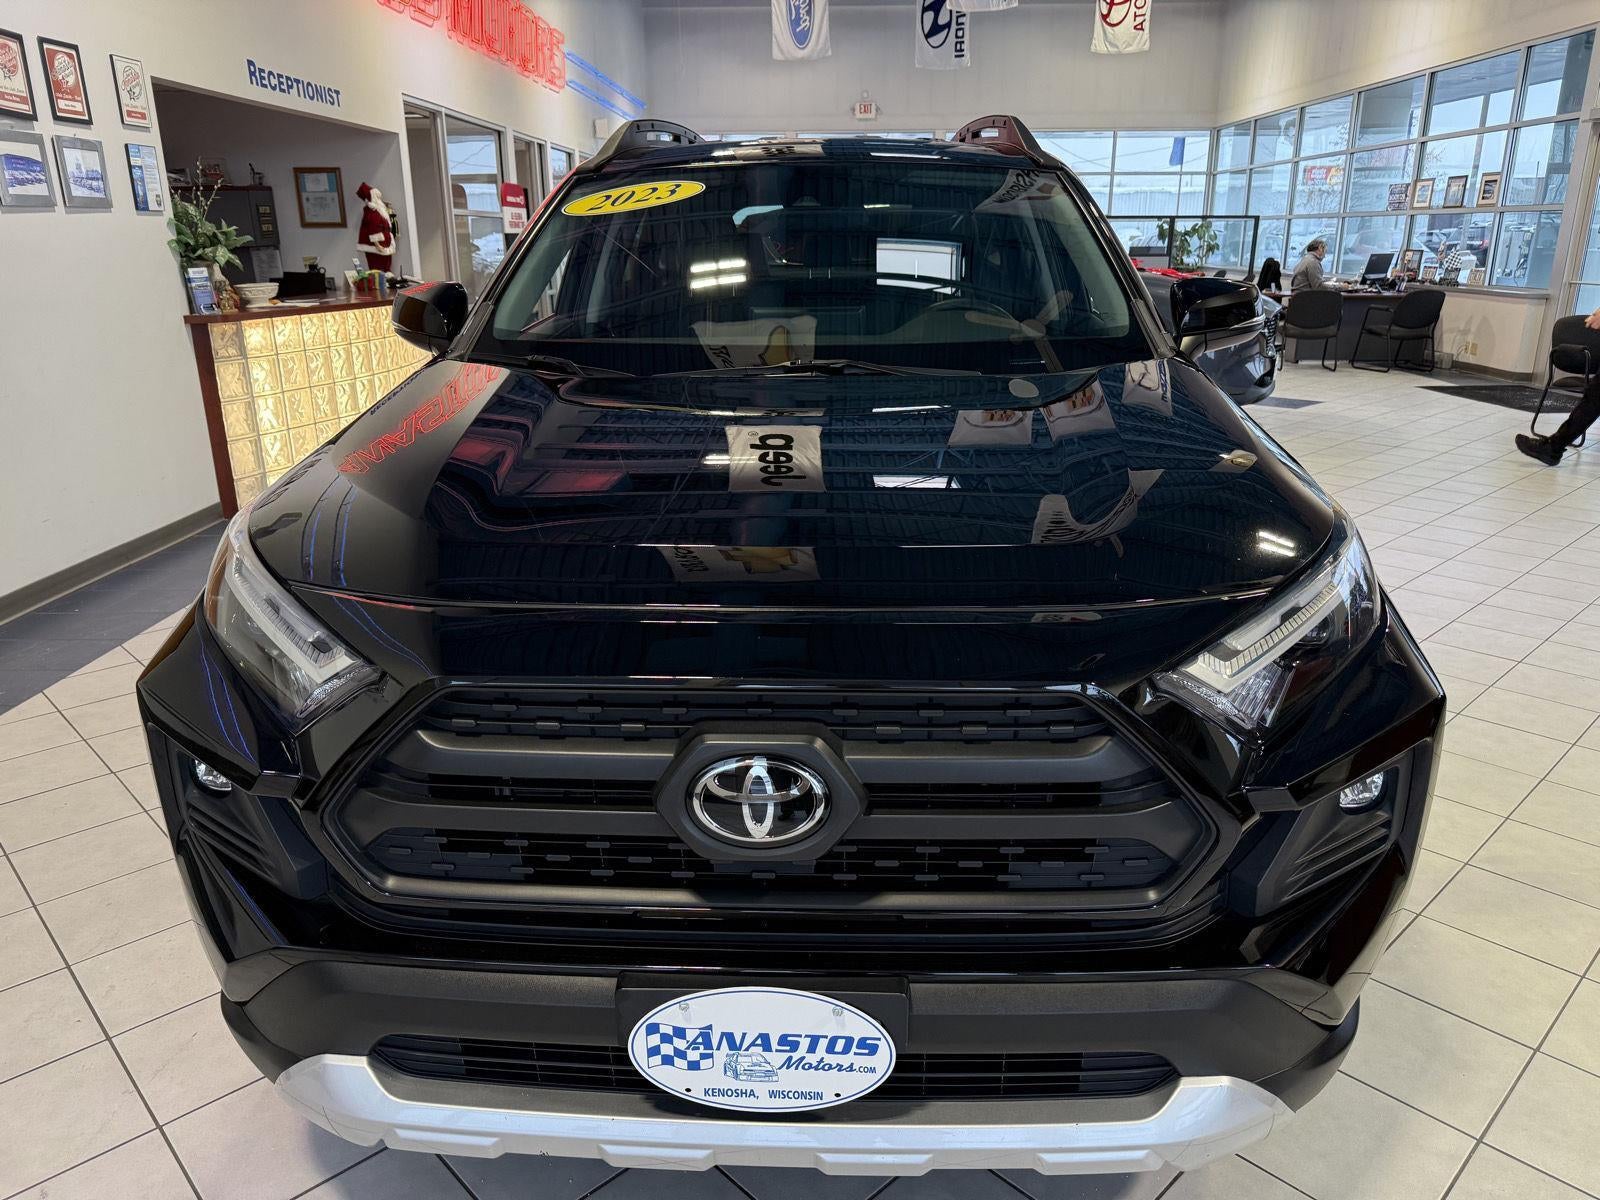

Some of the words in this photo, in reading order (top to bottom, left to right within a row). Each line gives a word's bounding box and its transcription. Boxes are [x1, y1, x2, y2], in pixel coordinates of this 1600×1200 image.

[246, 58, 341, 107] RECEPTIONIST
[859, 103, 872, 115] EXIT
[585, 183, 682, 212] 2023
[684, 1031, 882, 1057] ANASTOS
[703, 1087, 760, 1100] KENOSHA,
[767, 1089, 824, 1101] WISCONSIN
